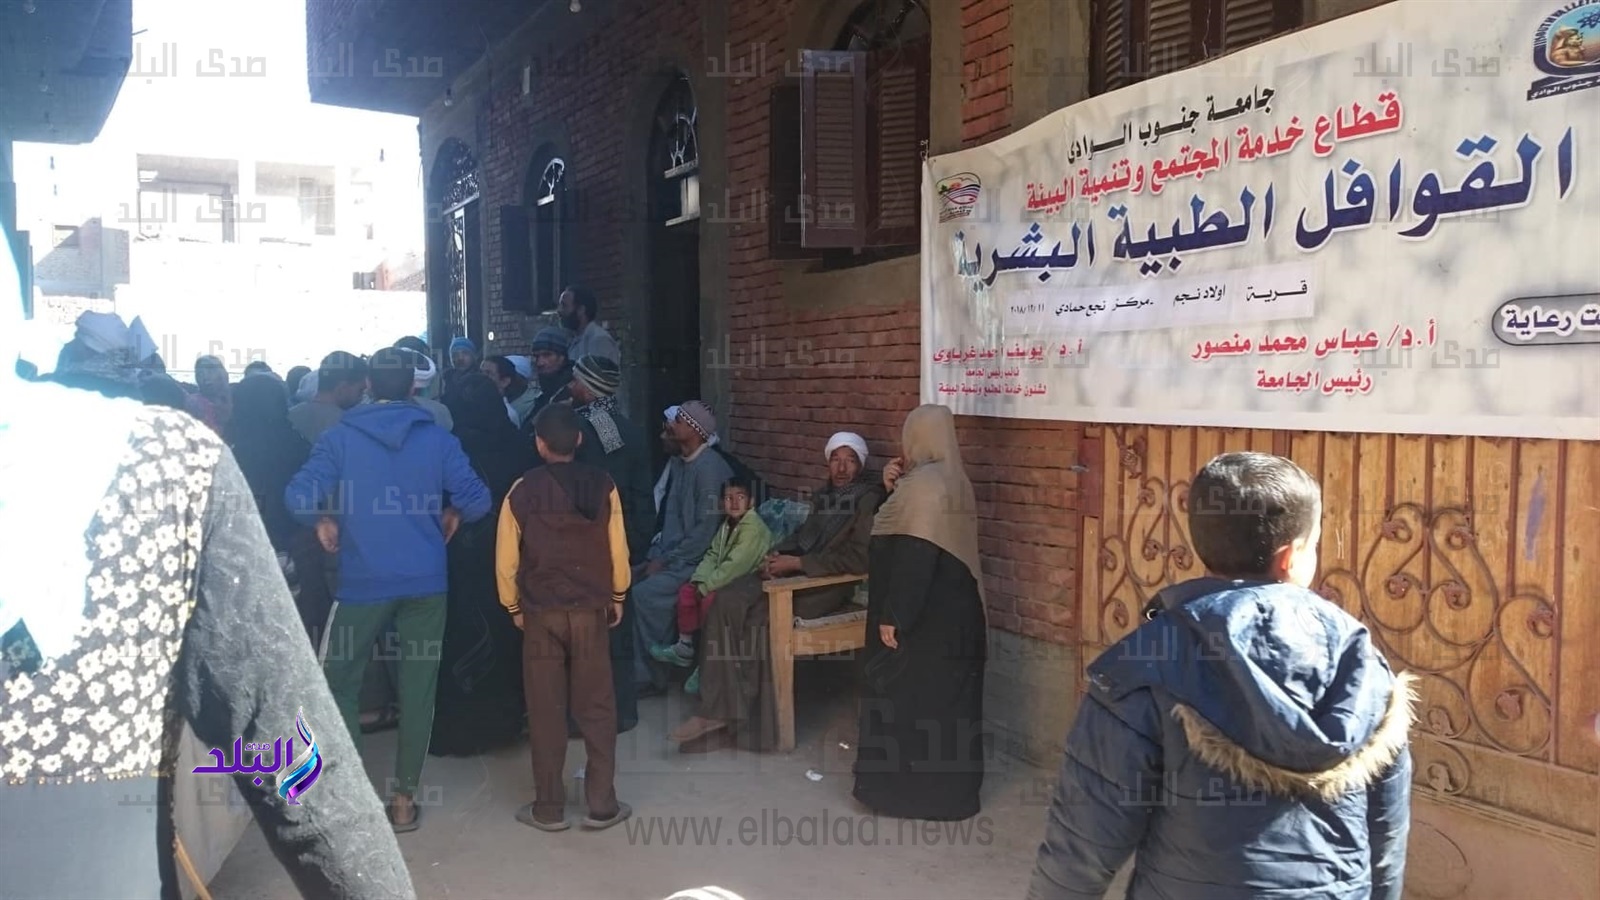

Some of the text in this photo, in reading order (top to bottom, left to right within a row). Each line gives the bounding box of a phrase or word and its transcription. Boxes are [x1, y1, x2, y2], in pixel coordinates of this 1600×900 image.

[1206, 85, 1275, 121] جامعة
[1313, 90, 1402, 153] قطاع
[1139, 106, 1199, 147] جنوب
[1237, 115, 1305, 159] خدمة
[1080, 159, 1144, 203] وتنمية
[1151, 137, 1230, 192] المجتمع
[1026, 177, 1075, 213] البيئة
[1295, 126, 1573, 250] القوافل
[1112, 182, 1273, 276] الطبية
[955, 218, 1095, 292] البشرية
[1246, 280, 1307, 302] قرية
[1506, 309, 1571, 335] رعاية
[1192, 332, 1252, 358] منصور
[1258, 333, 1307, 352] محمد
[1315, 328, 1379, 356] عباس
[1256, 368, 1372, 393] رئيس الجامعة
